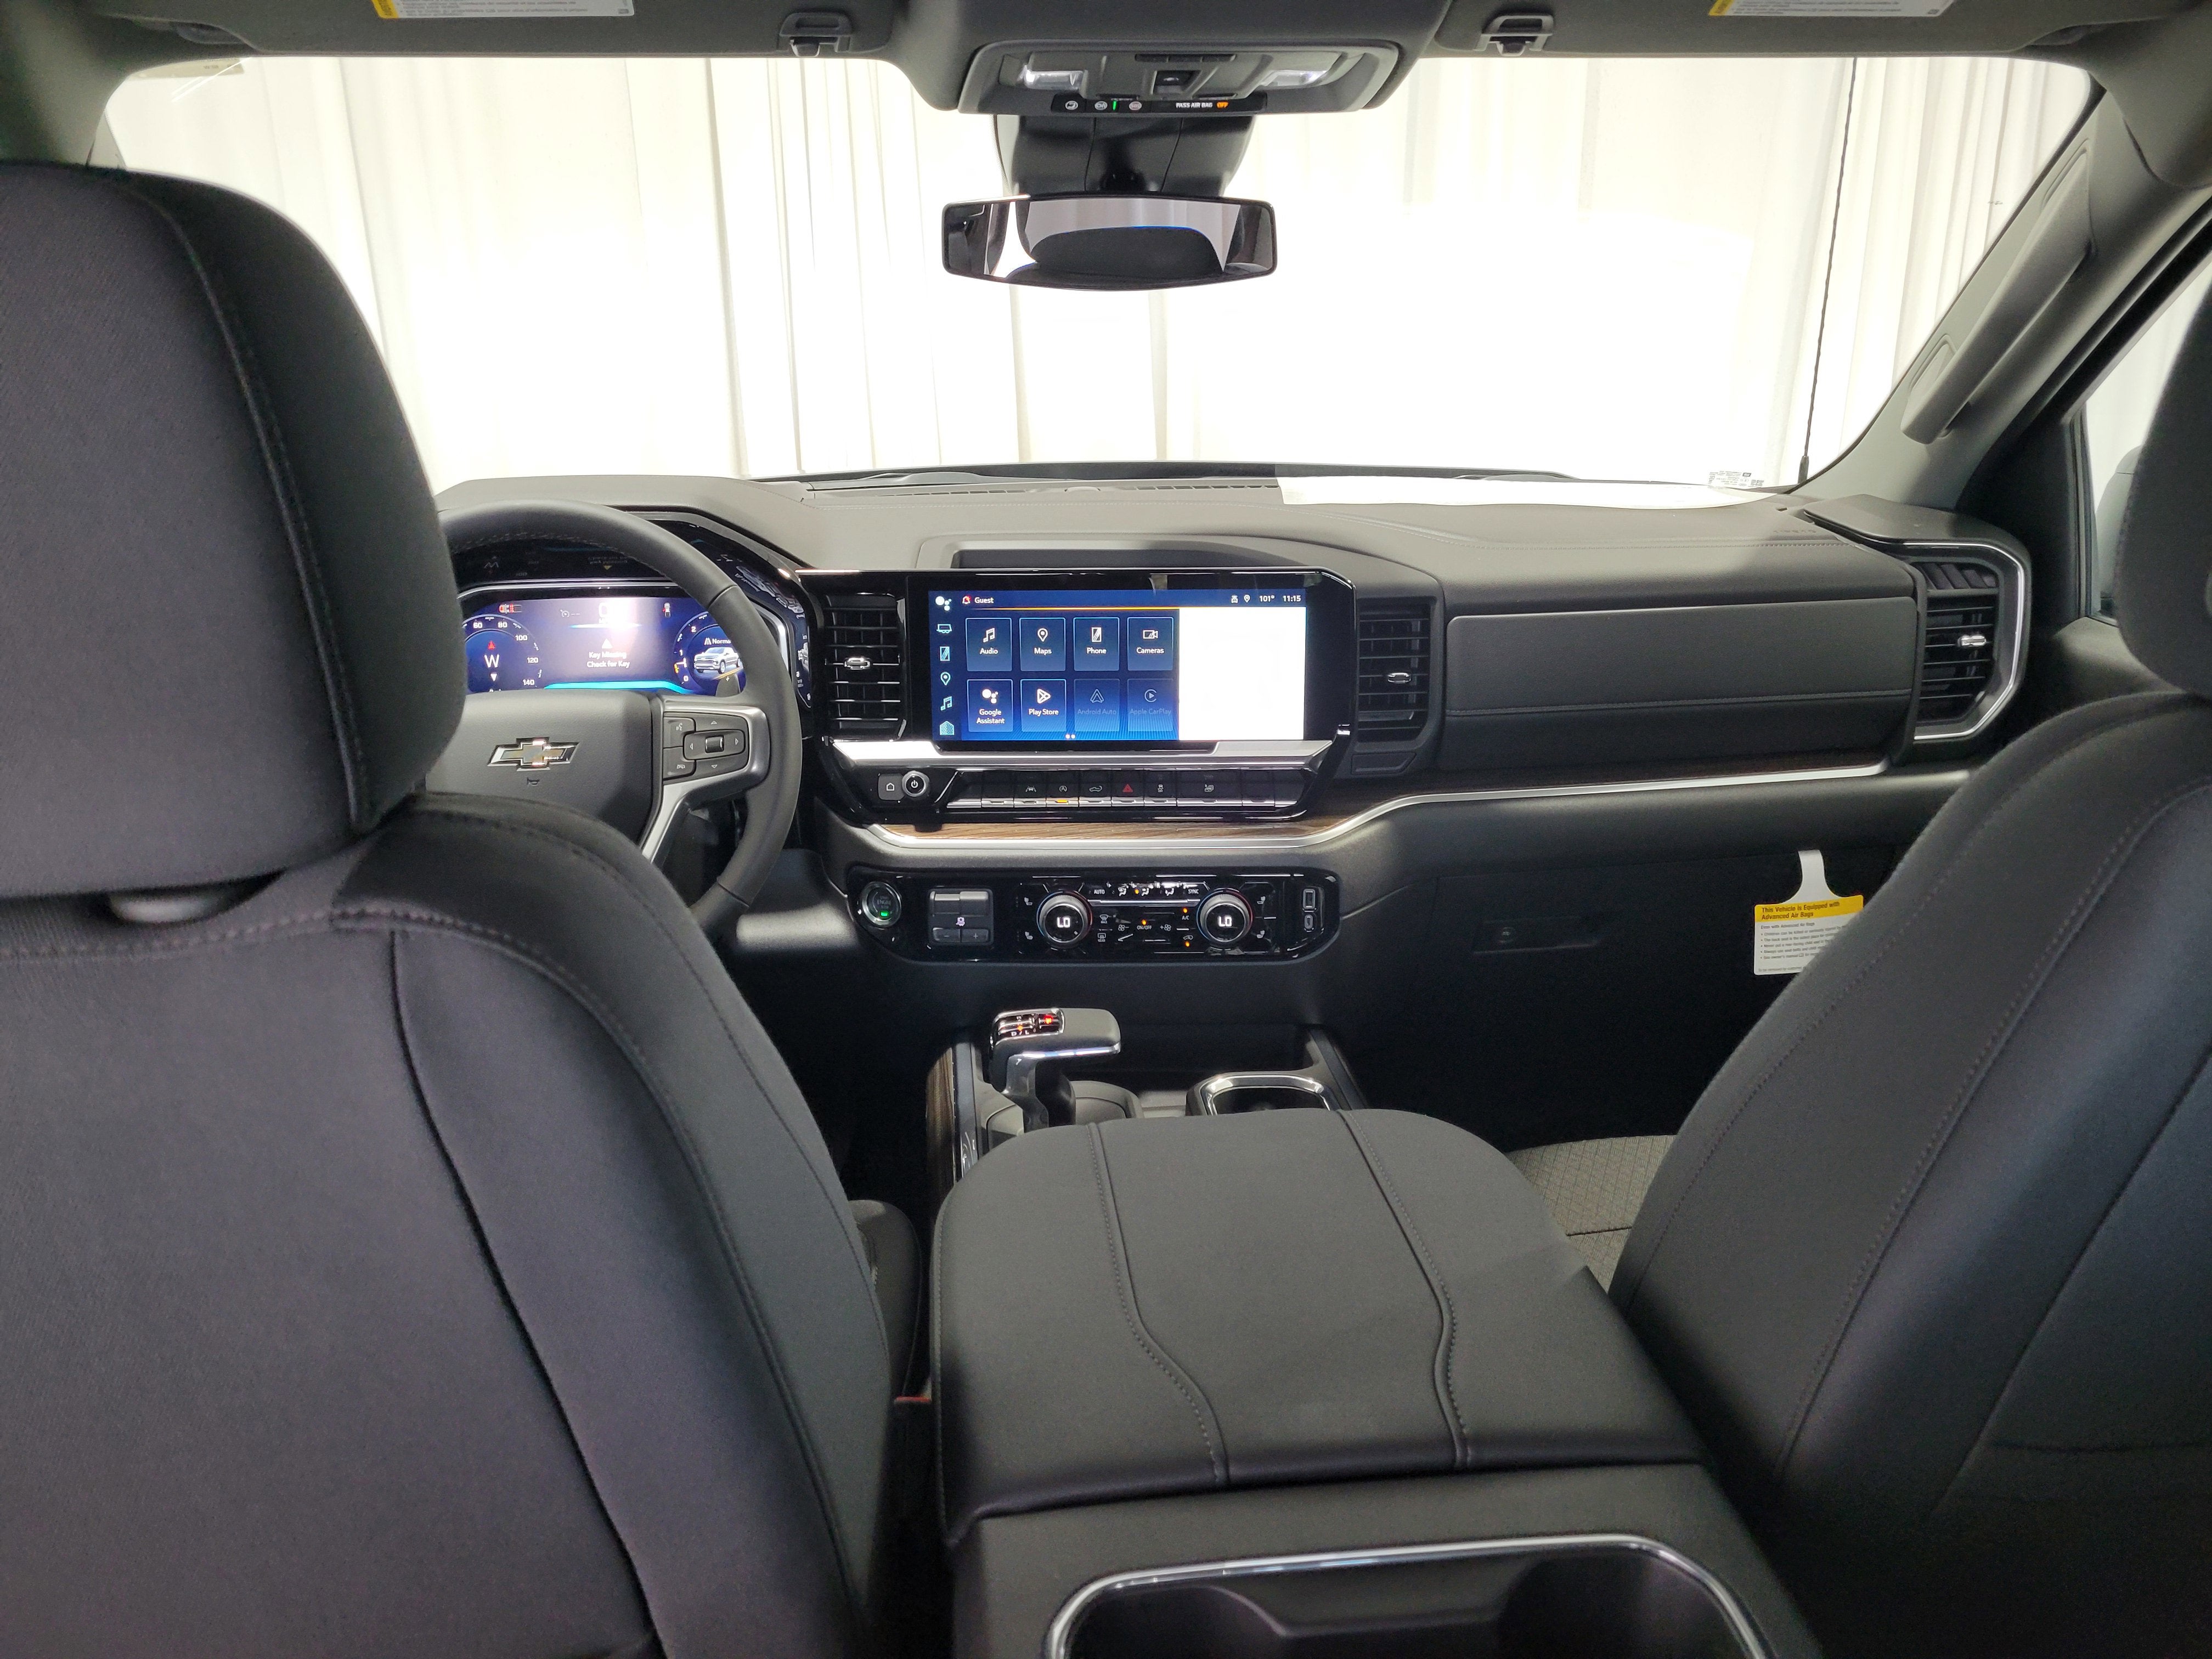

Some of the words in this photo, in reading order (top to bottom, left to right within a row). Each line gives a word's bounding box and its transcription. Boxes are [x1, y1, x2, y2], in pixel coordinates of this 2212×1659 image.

[589, 651, 601, 659] Key
[1034, 647, 1052, 656] Maps
[484, 654, 500, 668] W
[618, 660, 630, 668] Key
[1029, 708, 1041, 716] Play
[1803, 902, 1827, 911] Equipped
[1057, 916, 1070, 928] LO
[1218, 916, 1233, 927] LO
